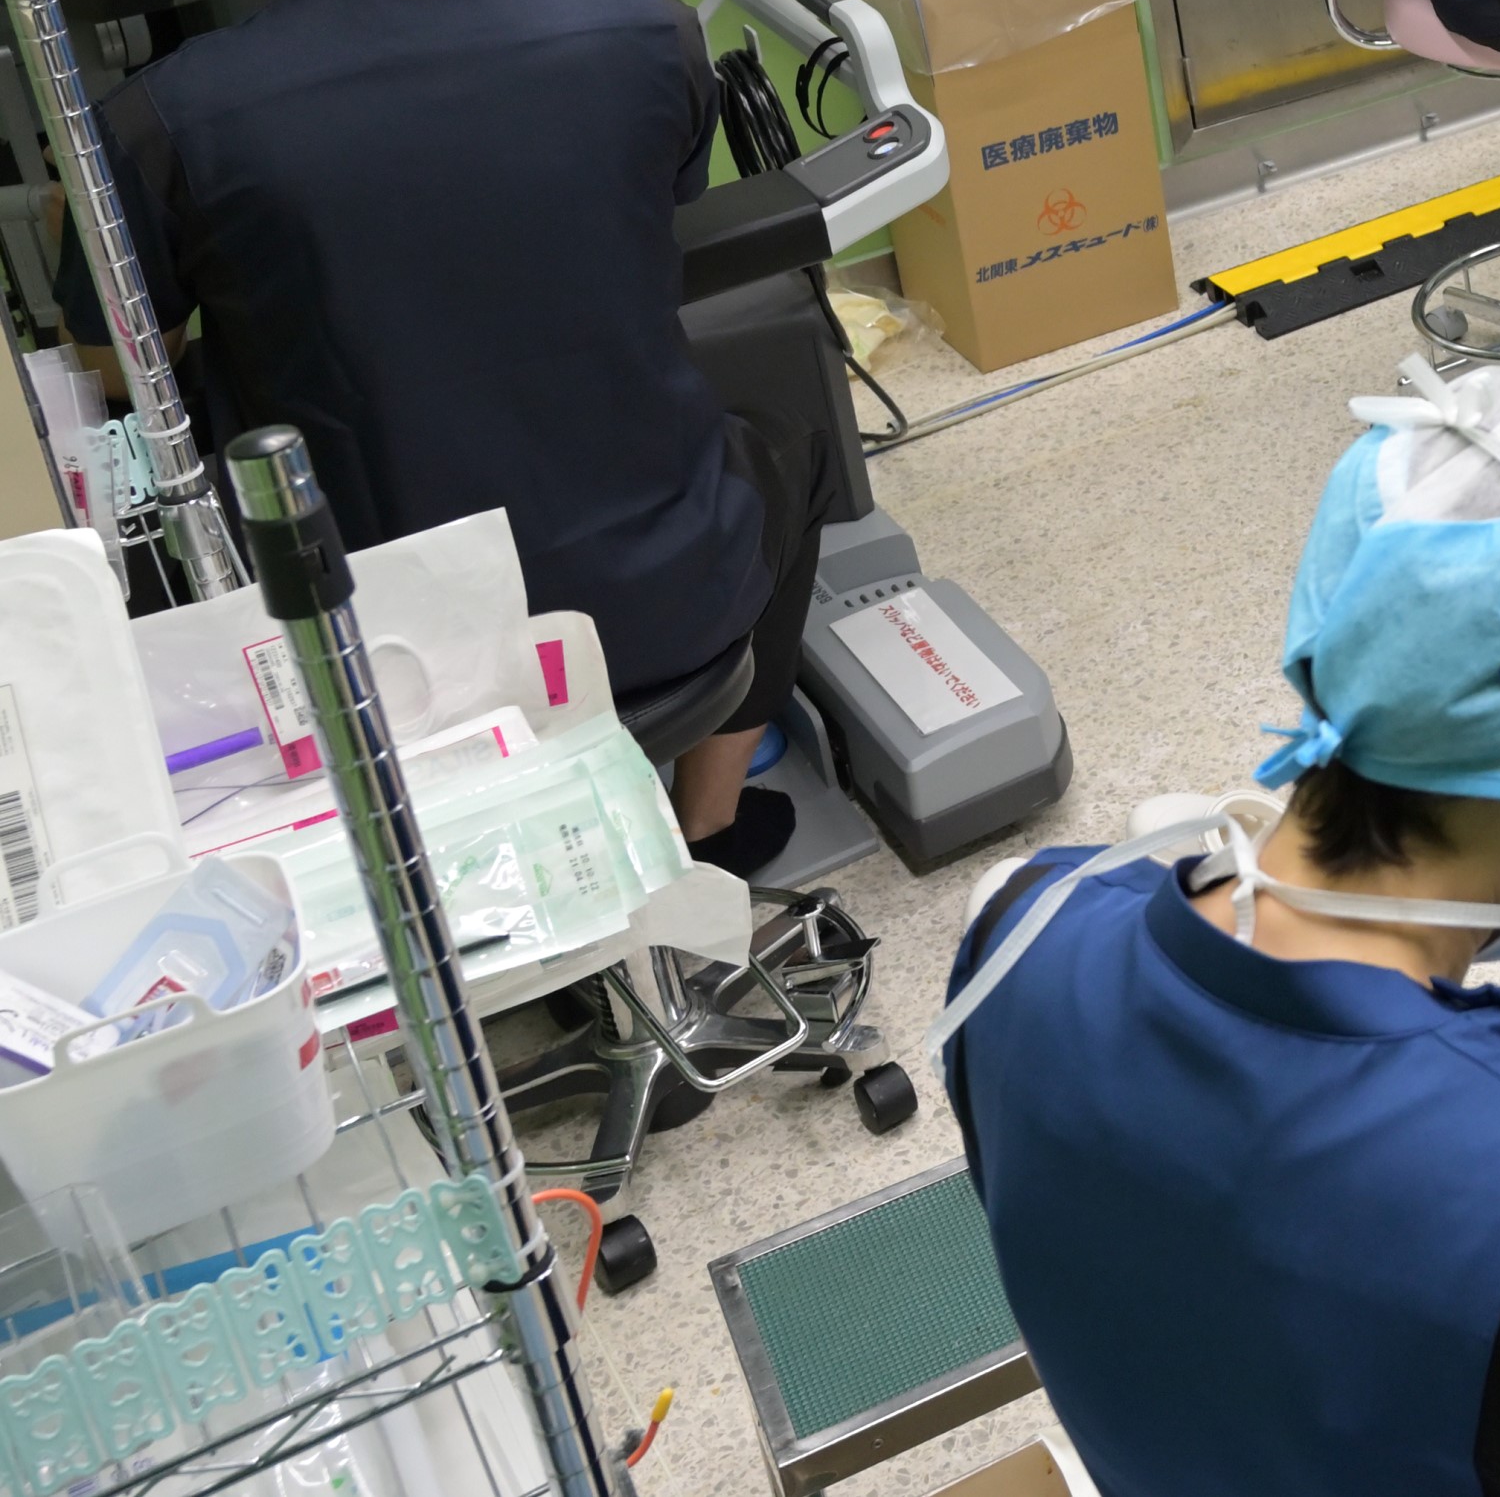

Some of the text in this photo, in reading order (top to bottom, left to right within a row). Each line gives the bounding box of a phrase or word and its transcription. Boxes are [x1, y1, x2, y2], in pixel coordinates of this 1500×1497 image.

[980, 111, 1121, 171] 医療廃棄物
[975, 256, 1019, 286] 北関東
